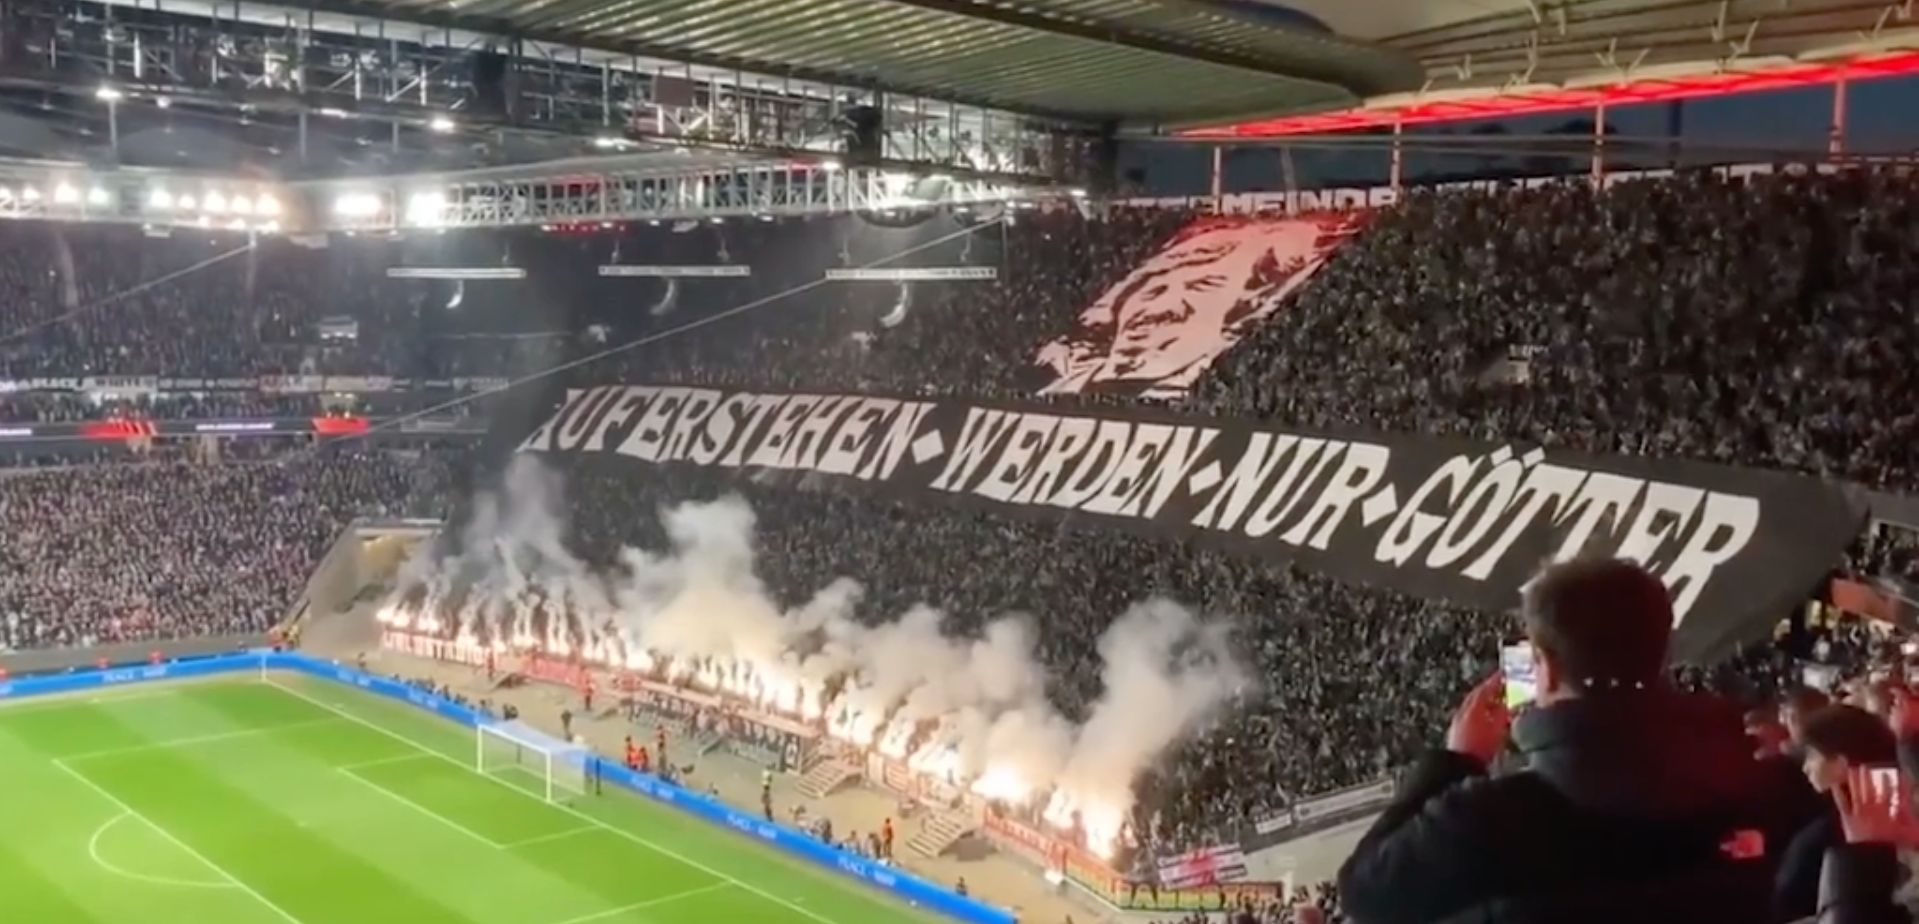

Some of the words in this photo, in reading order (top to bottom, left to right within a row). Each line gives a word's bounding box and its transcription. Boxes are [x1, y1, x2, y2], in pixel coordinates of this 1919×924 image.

[514, 385, 938, 480] AUFERSTEHEN
[928, 406, 1222, 519] WERDEN
[1191, 430, 1390, 551] NUR
[1374, 444, 1760, 630] GÖTTER
